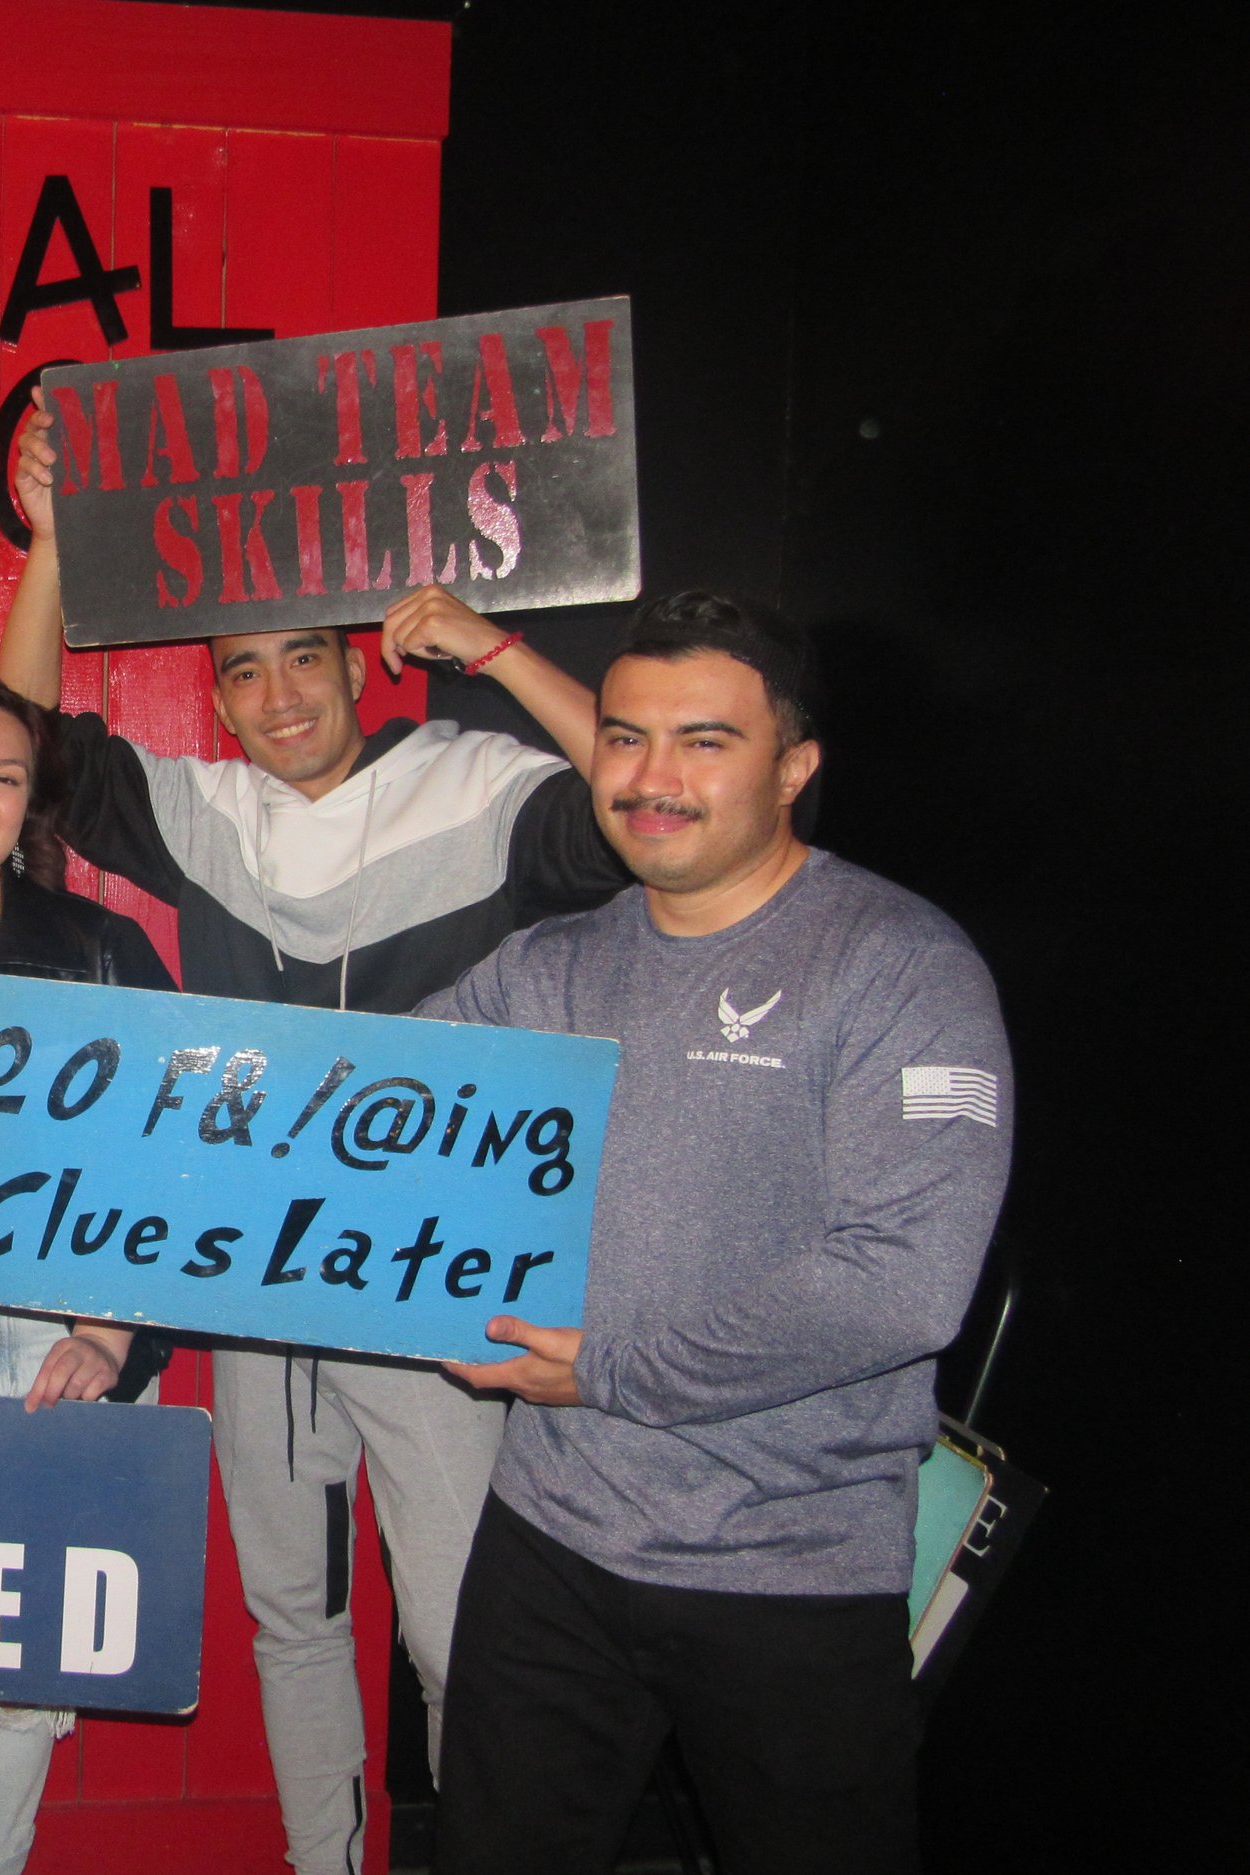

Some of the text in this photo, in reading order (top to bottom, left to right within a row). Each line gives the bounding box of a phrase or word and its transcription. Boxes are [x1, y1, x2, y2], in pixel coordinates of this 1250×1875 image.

[51, 319, 617, 496] MAD TEAM
[153, 460, 522, 609] SKILLS
[686, 1050, 705, 1060] U.S.
[706, 1051, 728, 1062] AIR
[261, 1197, 554, 1303] Later
